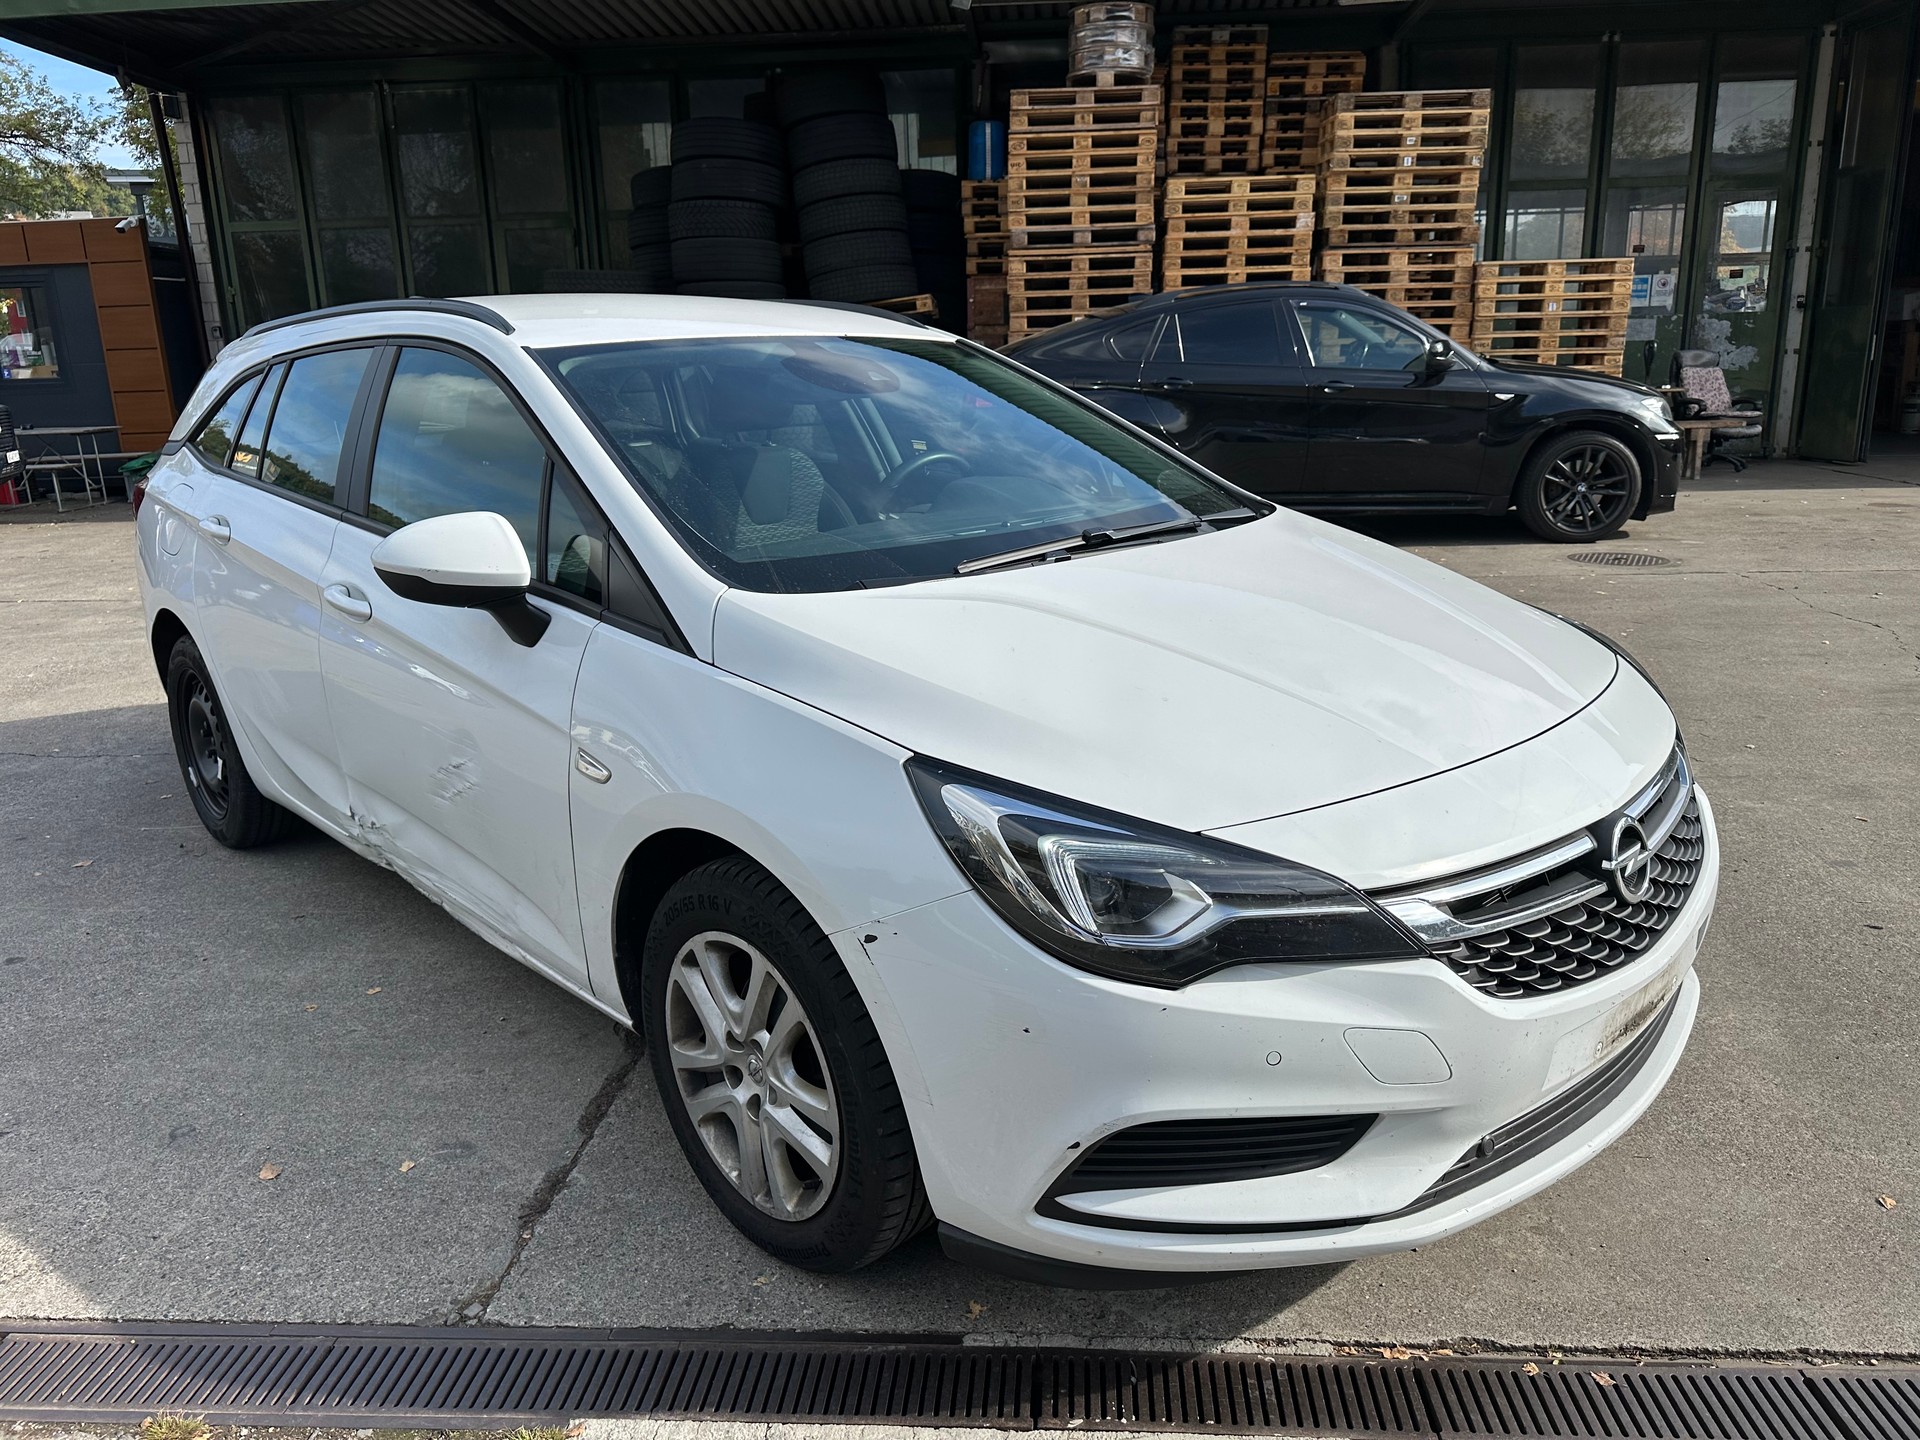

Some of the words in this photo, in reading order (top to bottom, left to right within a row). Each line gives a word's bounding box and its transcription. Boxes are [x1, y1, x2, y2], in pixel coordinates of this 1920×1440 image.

[663, 894, 695, 927] 205/55
[698, 894, 707, 910] R
[707, 894, 720, 912] 16
[723, 897, 733, 916] V
